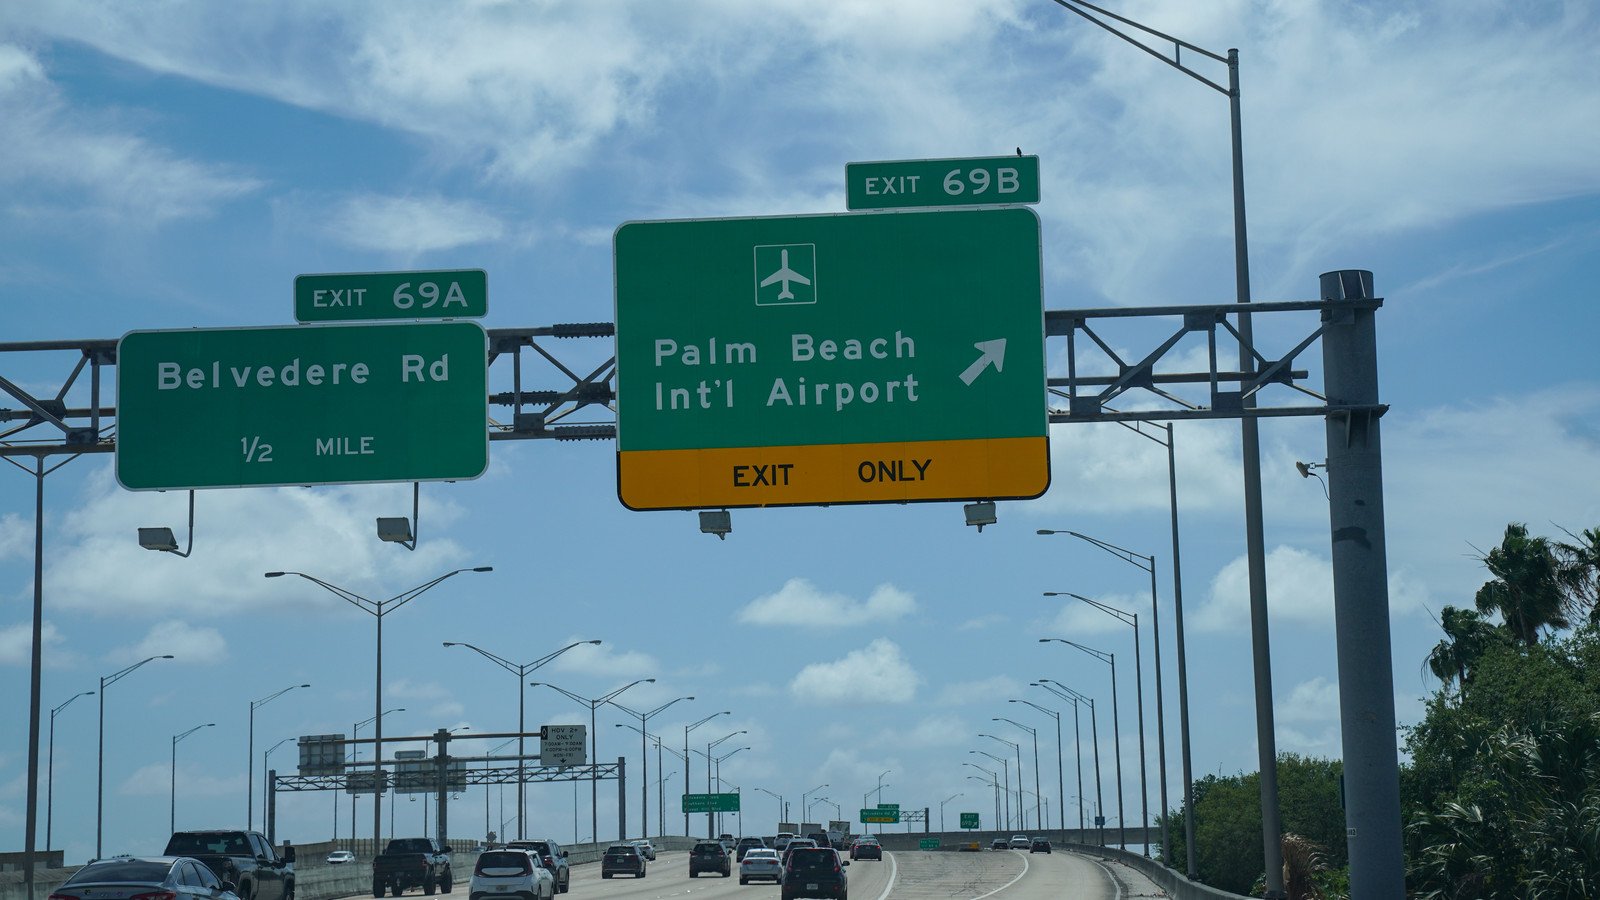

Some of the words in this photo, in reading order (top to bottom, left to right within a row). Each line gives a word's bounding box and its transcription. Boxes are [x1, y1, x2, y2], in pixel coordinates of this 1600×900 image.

[866, 176, 919, 194] EXIT
[944, 168, 1019, 195] 69B
[315, 289, 366, 306] EXIT
[394, 283, 467, 308] 69A
[656, 338, 756, 365] Palm
[792, 331, 914, 361] Beach
[159, 359, 368, 389] Belvedere
[403, 354, 448, 381] Rd
[657, 380, 732, 409] Int'l
[767, 374, 918, 411] Airport
[317, 437, 373, 455] MILE
[734, 464, 793, 487] EXIT
[858, 459, 931, 483] ONLY
